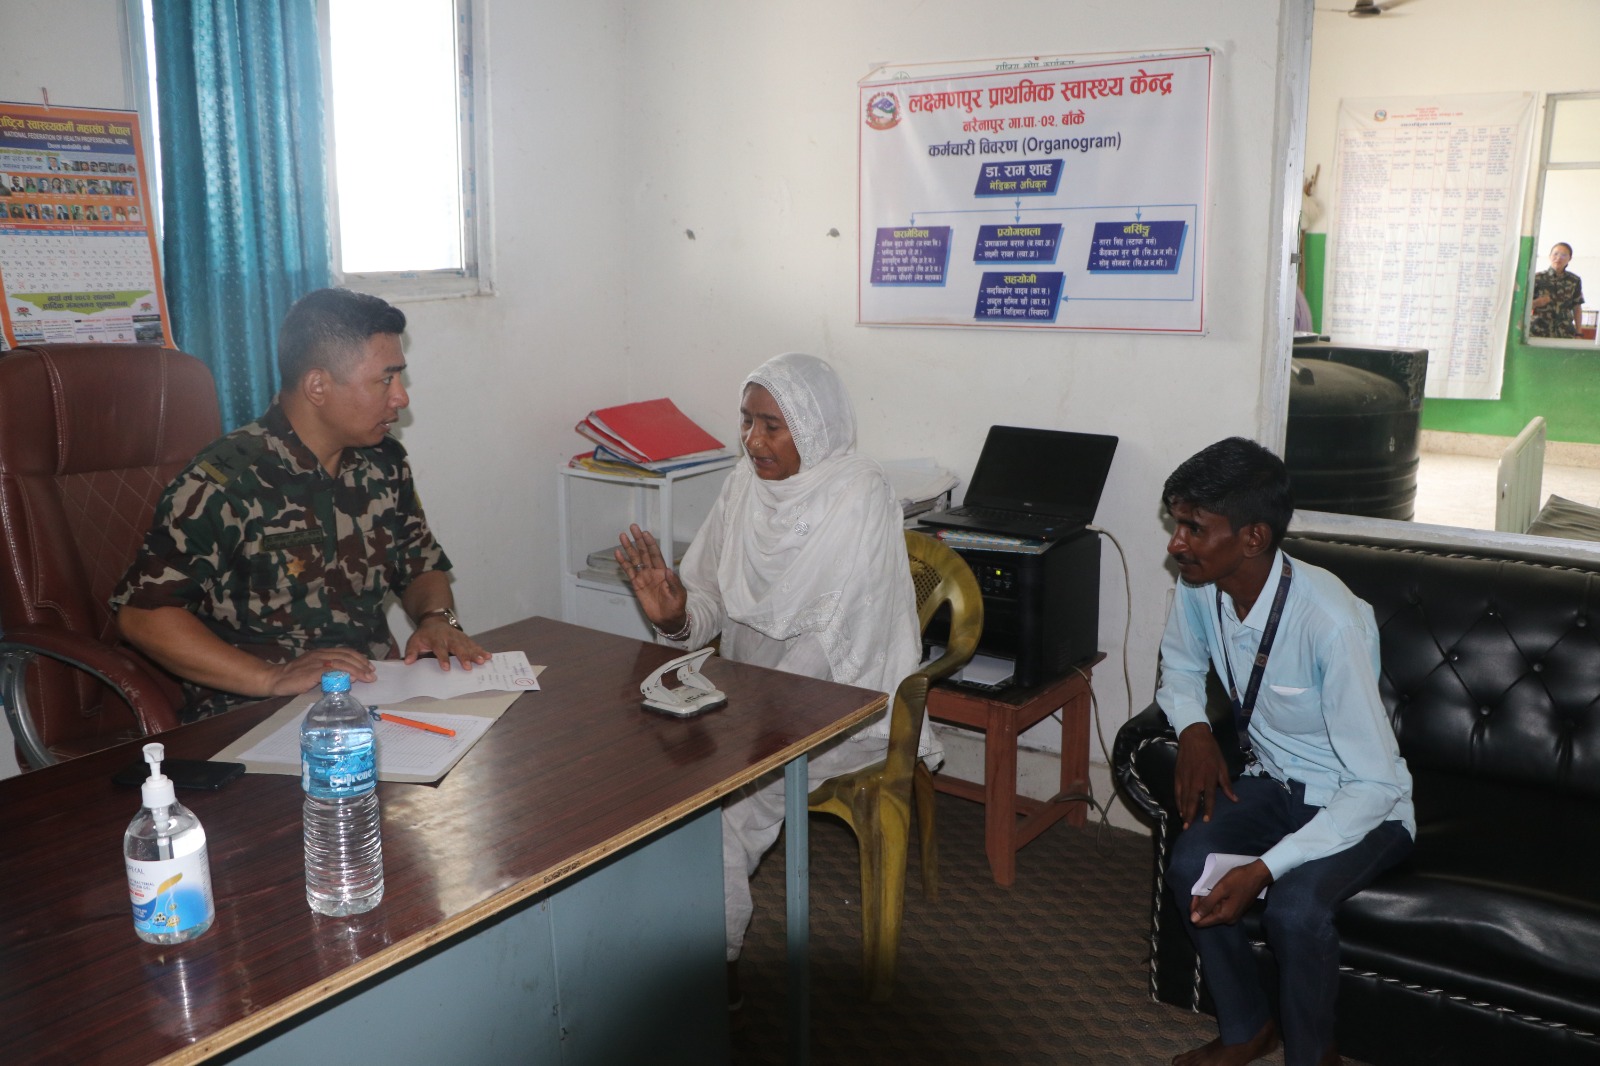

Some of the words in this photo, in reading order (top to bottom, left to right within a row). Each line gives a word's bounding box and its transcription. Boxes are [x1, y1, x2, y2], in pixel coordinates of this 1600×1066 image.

[909, 89, 983, 114] लक्ष्मणपुर
[988, 79, 1054, 108] प्राथमिक
[1061, 77, 1124, 102] स्वास्थ्य
[1130, 69, 1173, 96] केन्द्र
[0, 116, 25, 130] ाष्ट्रिय
[963, 116, 1005, 134] नरैनापुर
[1062, 110, 1085, 126] बाँके
[4, 131, 27, 139] NATIONAL
[28, 133, 56, 141] FEDERATION
[929, 139, 975, 158] कर्मचारी
[980, 137, 1019, 154] विवरण
[1023, 132, 1122, 157] (Organogram)
[986, 167, 1001, 178] डा.
[1004, 165, 1026, 177] राम
[1029, 164, 1053, 176] शाह
[990, 180, 1017, 191] मेडिकल
[1020, 178, 1048, 192] अधिकृत
[997, 227, 1041, 238] प्रयोगशाला
[1004, 274, 1037, 285] सहयोगी
